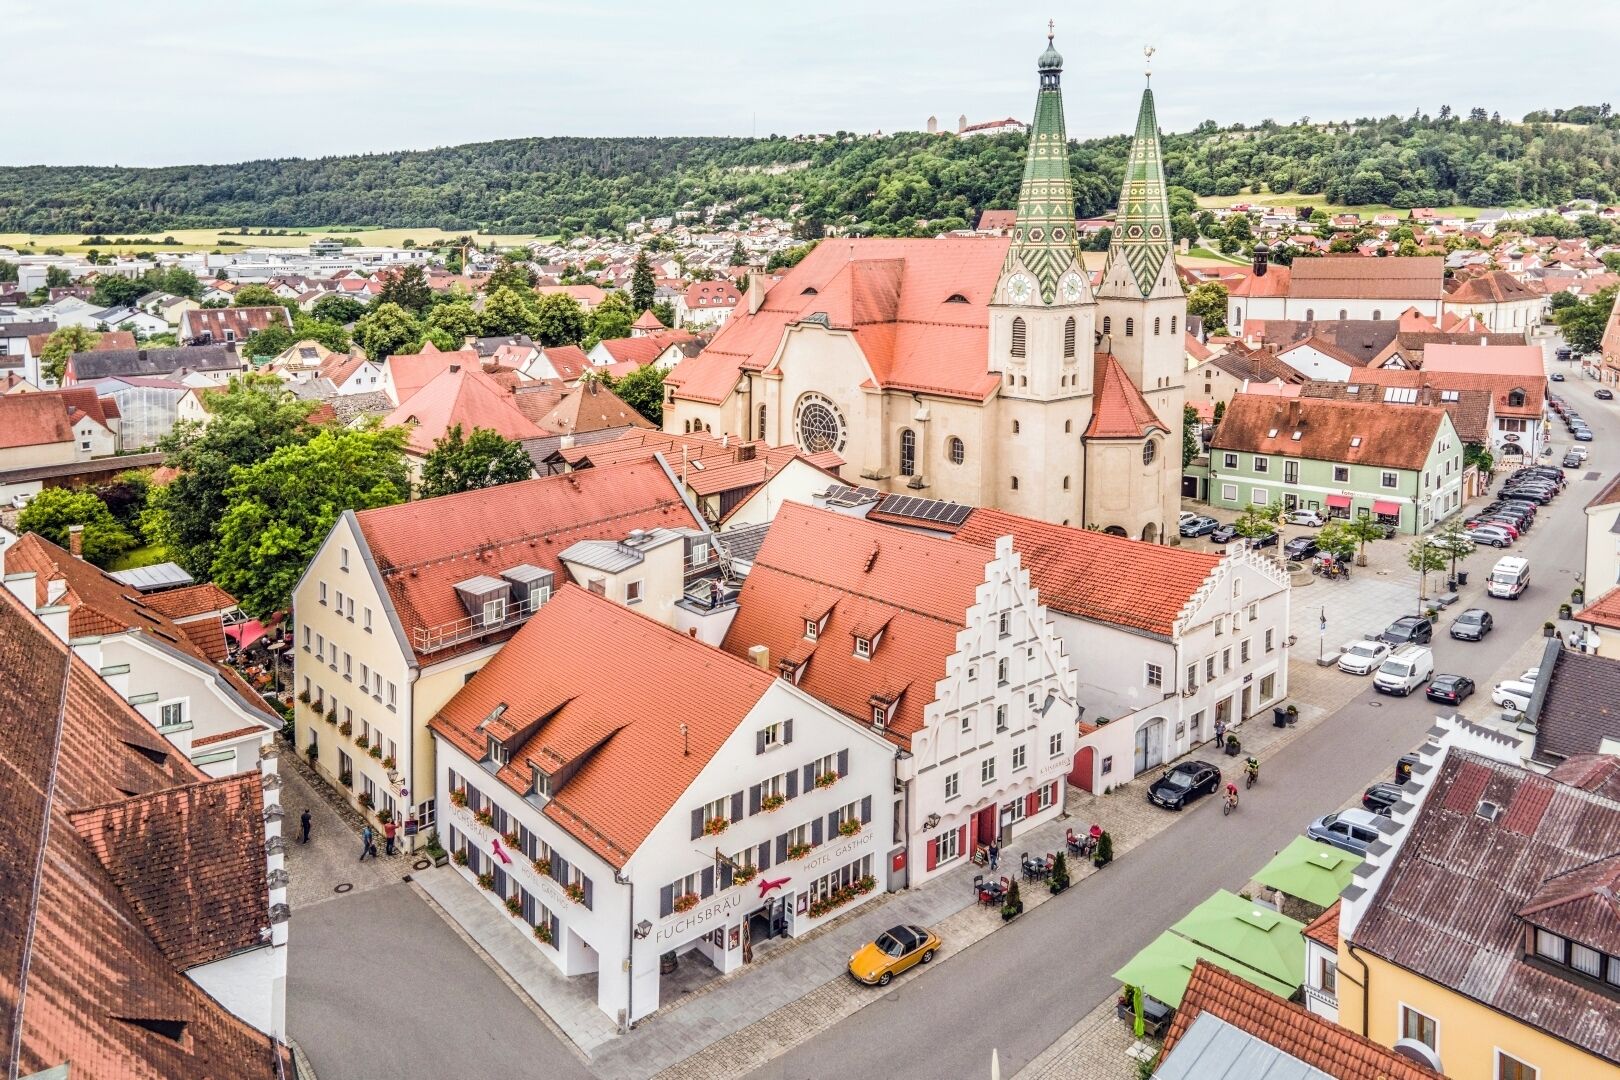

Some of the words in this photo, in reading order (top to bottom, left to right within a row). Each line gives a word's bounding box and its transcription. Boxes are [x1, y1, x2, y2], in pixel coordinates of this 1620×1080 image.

[803, 853, 832, 872] HOTEL
[835, 832, 874, 857] GASTHOF
[656, 894, 741, 943] FUCHSBRÄU
